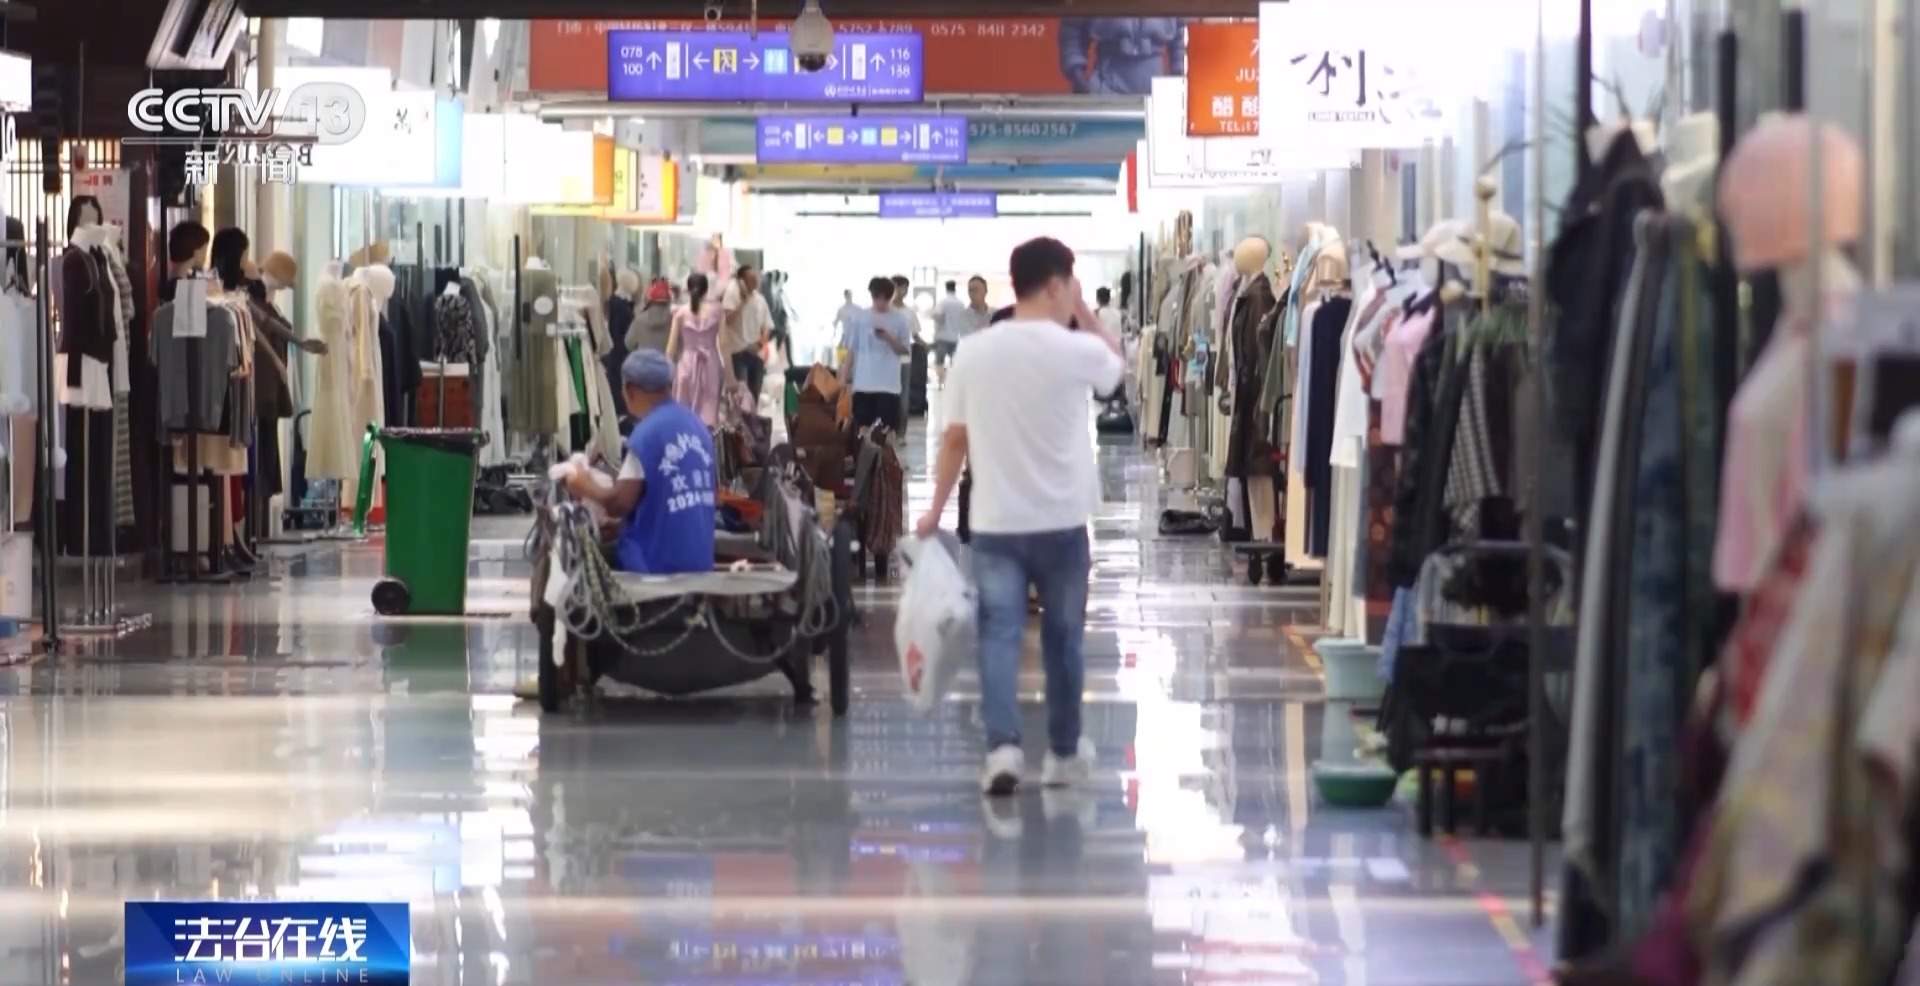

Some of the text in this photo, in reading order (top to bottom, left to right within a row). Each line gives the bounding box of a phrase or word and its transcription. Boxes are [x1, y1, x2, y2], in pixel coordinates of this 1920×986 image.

[620, 46, 643, 58] 078
[890, 48, 911, 60] 116
[622, 63, 643, 75] 100
[1235, 68, 1259, 83] JU
